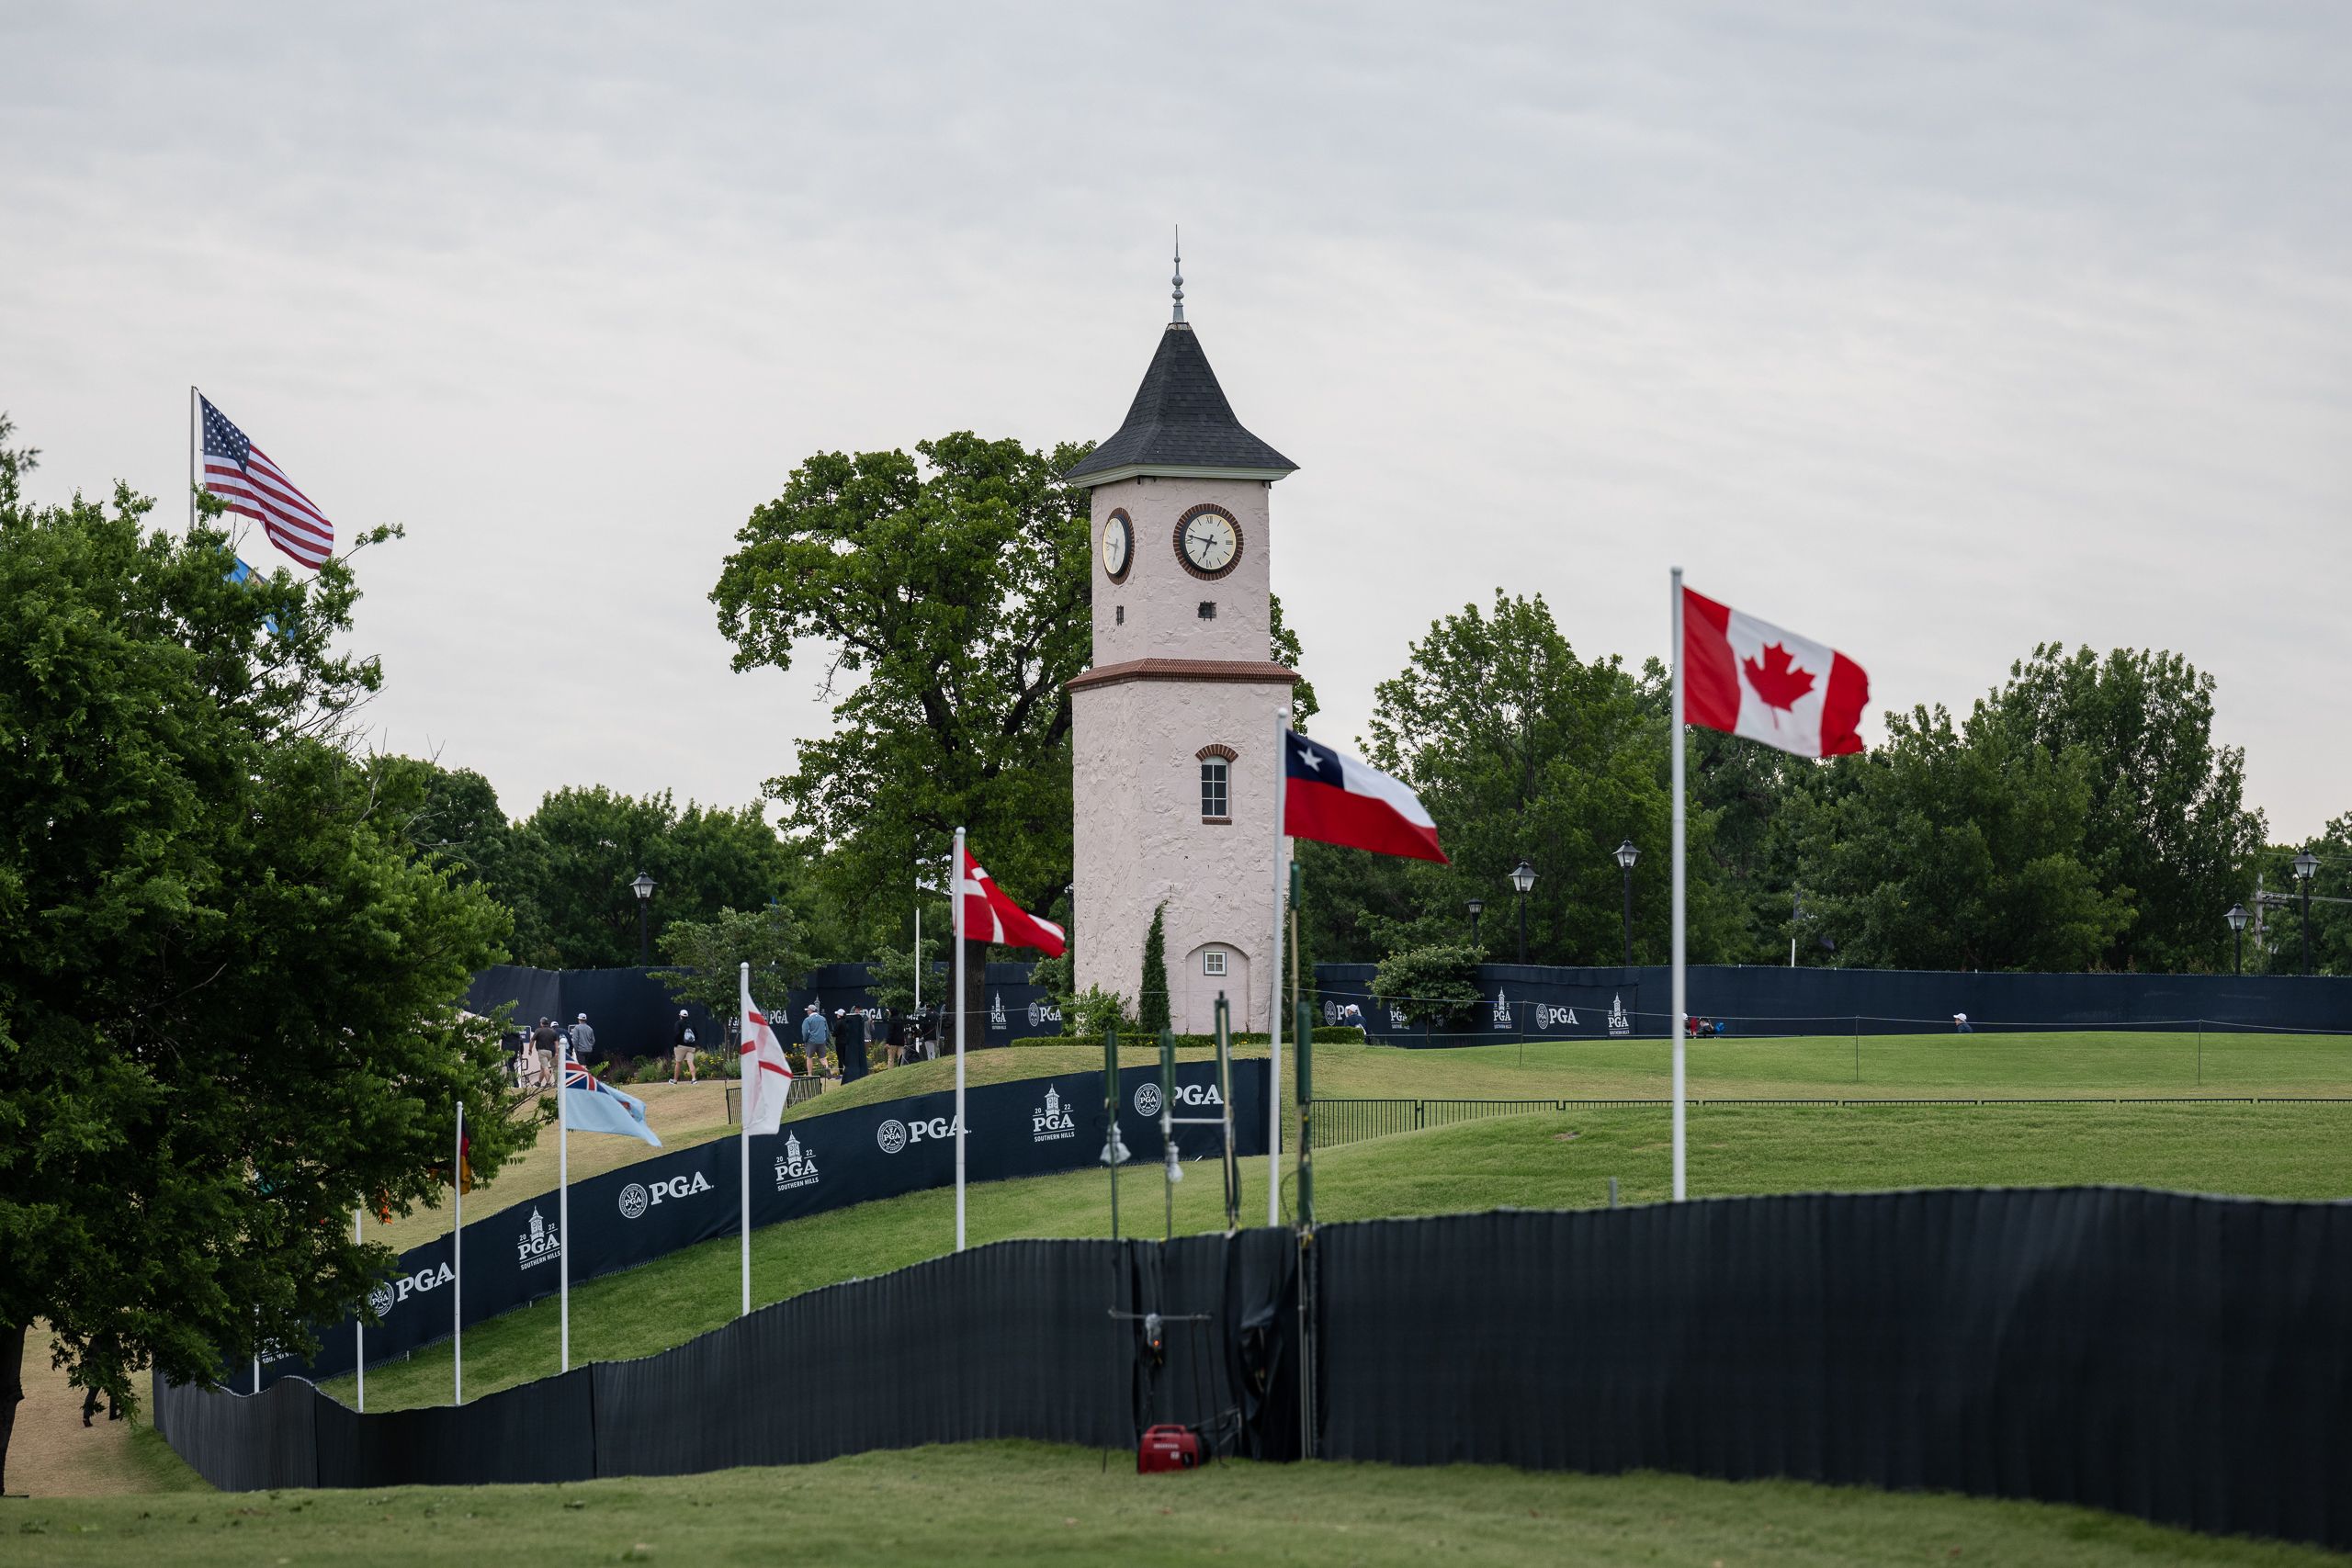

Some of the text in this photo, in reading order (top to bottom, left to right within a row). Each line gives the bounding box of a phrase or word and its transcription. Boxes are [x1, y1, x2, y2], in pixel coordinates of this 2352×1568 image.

[769, 1010, 789, 1025] PGA
[991, 1012, 1006, 1022] PGA
[1493, 1010, 1511, 1021] PGA
[1608, 1016, 1629, 1028] PGA
[1032, 1113, 1075, 1132] PGA
[1034, 1131, 1075, 1143] SOUTHERN HILLS
[775, 1159, 819, 1181] PGA
[777, 1177, 820, 1191] SOUTHERN HILLS
[519, 1223, 556, 1242] 20 22
[517, 1234, 560, 1260] PGA
[520, 1250, 561, 1270] SOUTHERN HILLS
[395, 1261, 456, 1303] PGA
